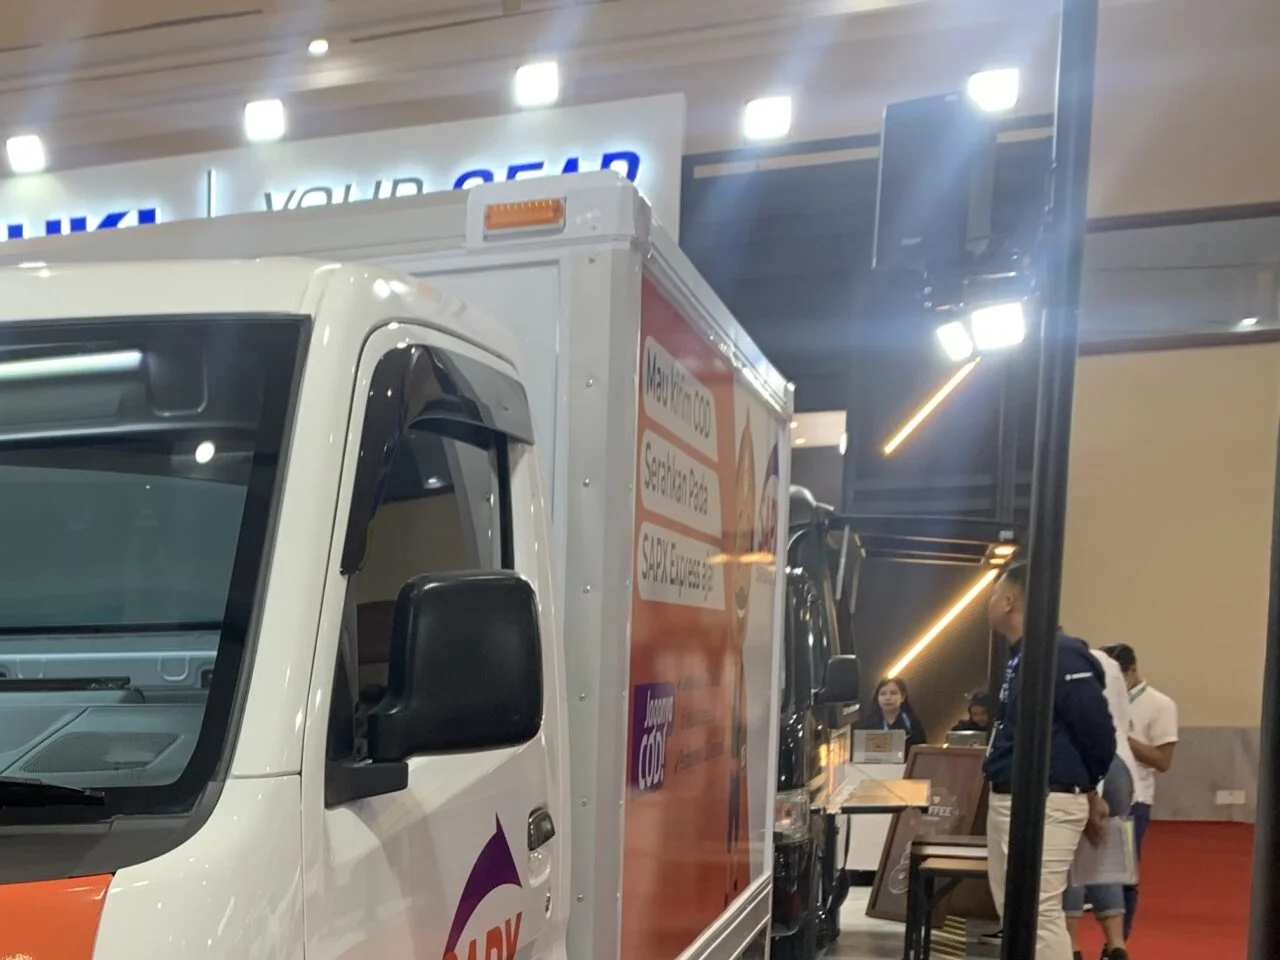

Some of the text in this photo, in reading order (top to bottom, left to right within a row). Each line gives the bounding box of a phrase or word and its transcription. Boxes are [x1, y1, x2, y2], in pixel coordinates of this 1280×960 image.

[646, 348, 668, 407] Mau
[644, 441, 708, 515] Serahkan Pada
[642, 532, 667, 583] SAPX
[669, 543, 701, 597] Express
